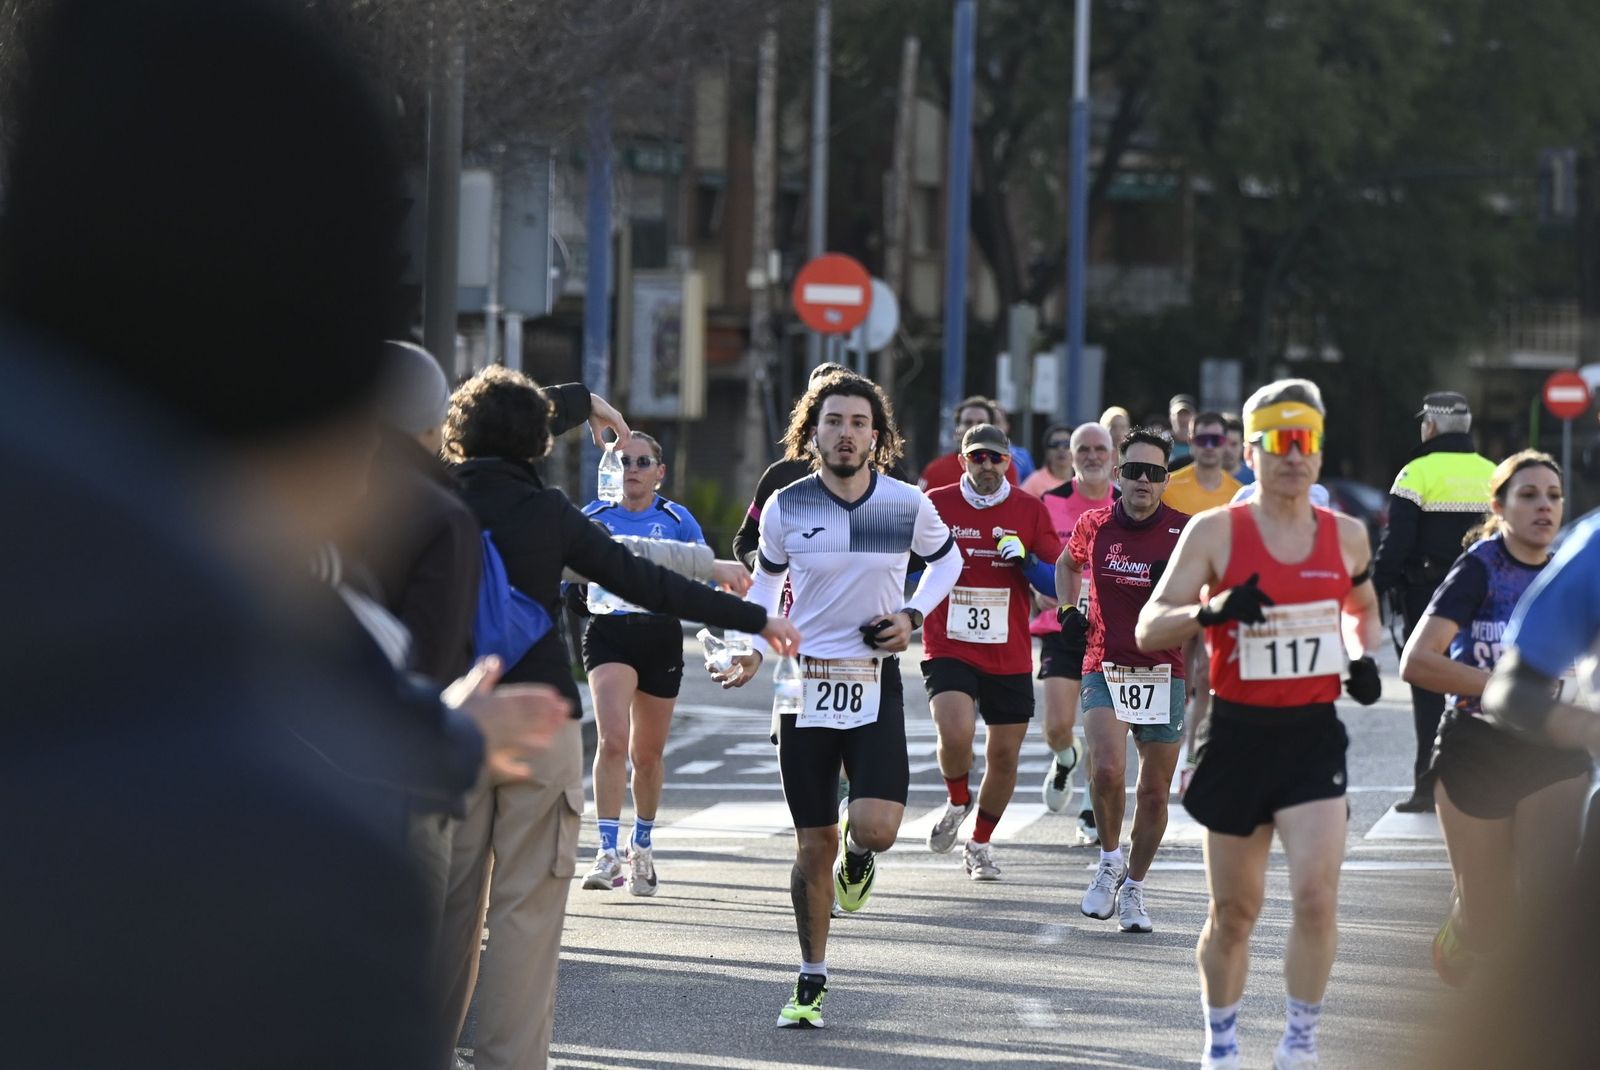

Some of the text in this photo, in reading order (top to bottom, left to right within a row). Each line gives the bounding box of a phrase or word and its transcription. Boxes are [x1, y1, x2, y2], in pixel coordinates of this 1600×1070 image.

[1105, 554, 1130, 563] PINK
[967, 607, 990, 630] 33
[1265, 637, 1320, 675] 117
[816, 681, 864, 713] 208
[1119, 684, 1155, 710] 487
